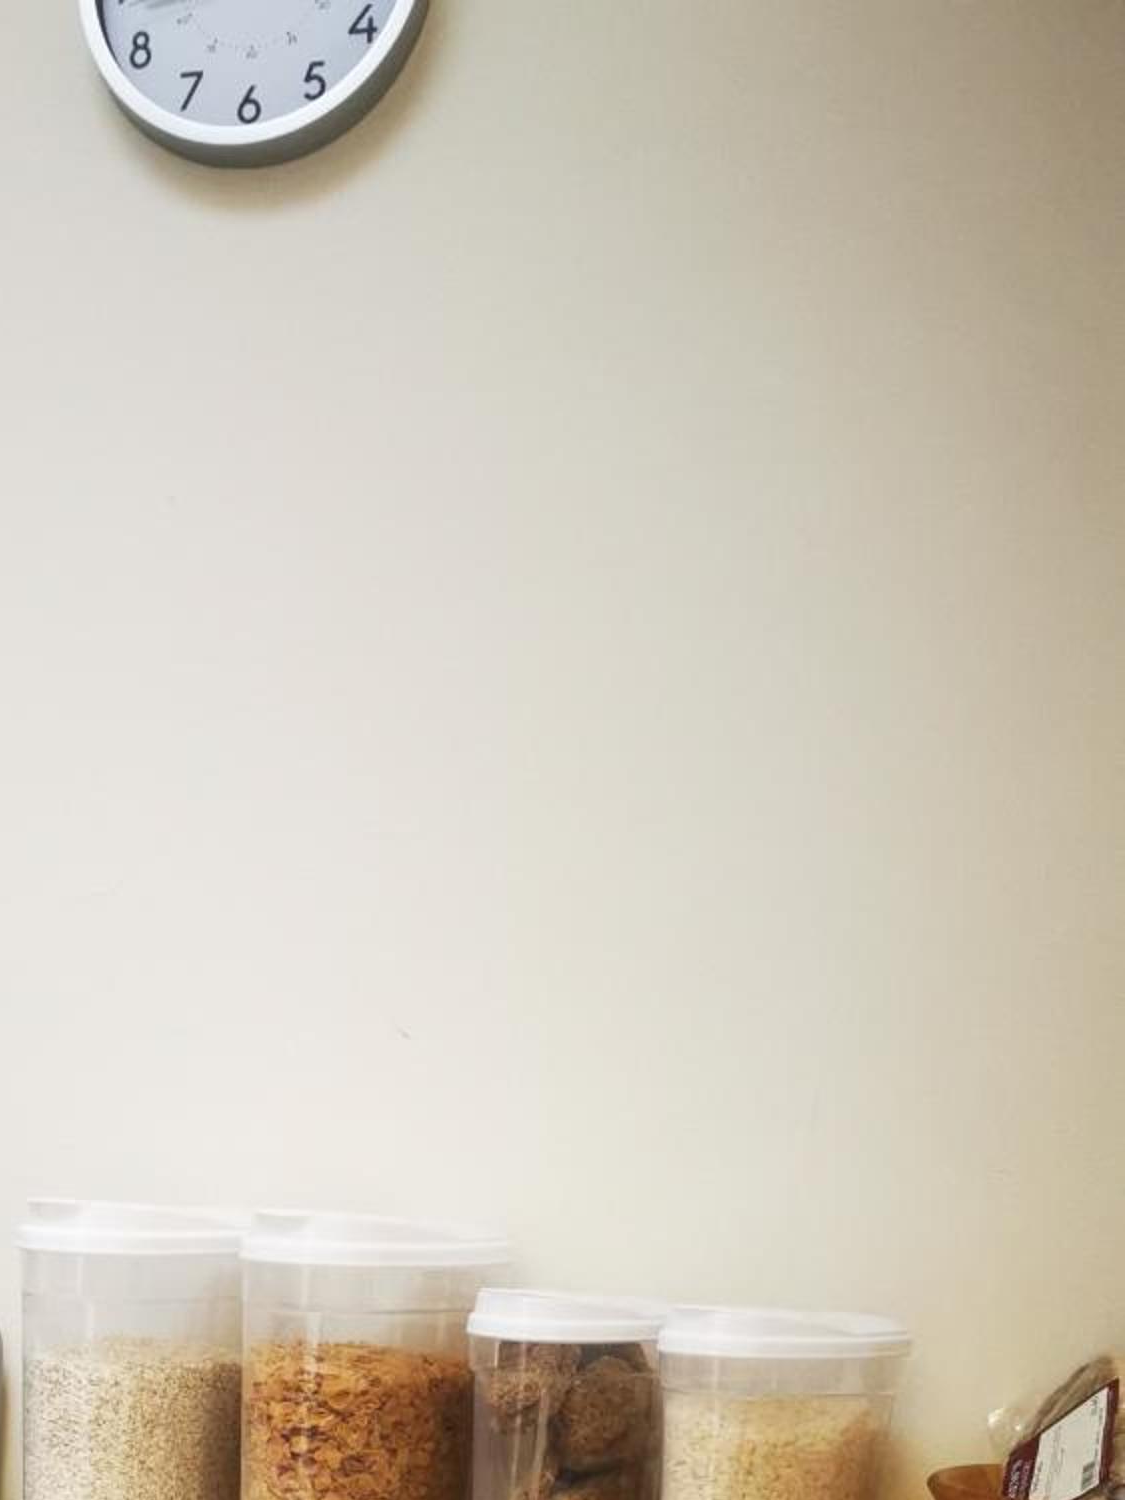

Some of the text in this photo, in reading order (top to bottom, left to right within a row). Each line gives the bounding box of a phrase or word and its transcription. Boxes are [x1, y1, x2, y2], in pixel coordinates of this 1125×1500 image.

[347, 4, 377, 43] 4
[129, 31, 152, 69] 8
[180, 70, 204, 112] 7
[303, 61, 326, 100] 5
[237, 85, 261, 124] 6
